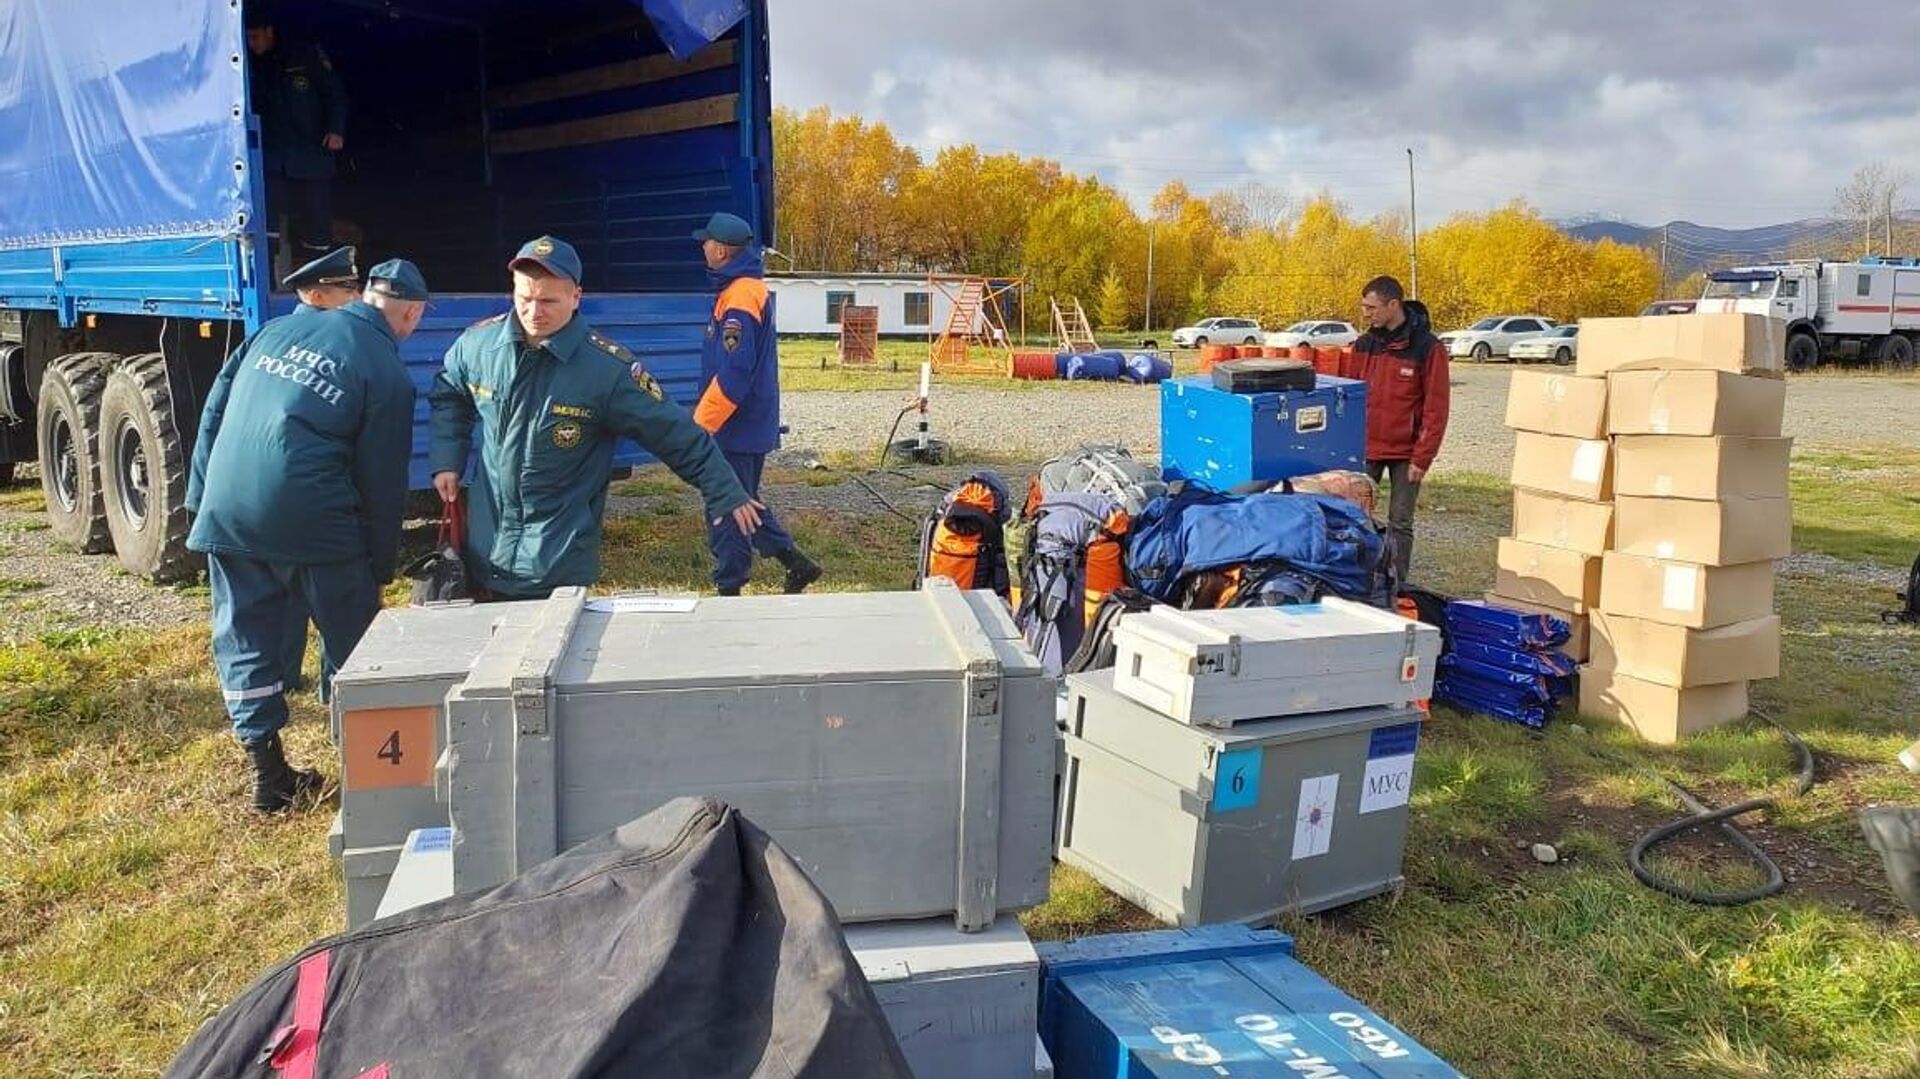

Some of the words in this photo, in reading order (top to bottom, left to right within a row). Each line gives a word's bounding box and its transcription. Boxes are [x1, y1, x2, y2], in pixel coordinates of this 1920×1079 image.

[282, 345, 336, 377] МЧС
[255, 355, 345, 404] РОССИИ
[377, 730, 403, 765] 4
[1232, 764, 1249, 794] 6
[1368, 771, 1408, 797] МУС
[1329, 1012, 1409, 1059] КБО
